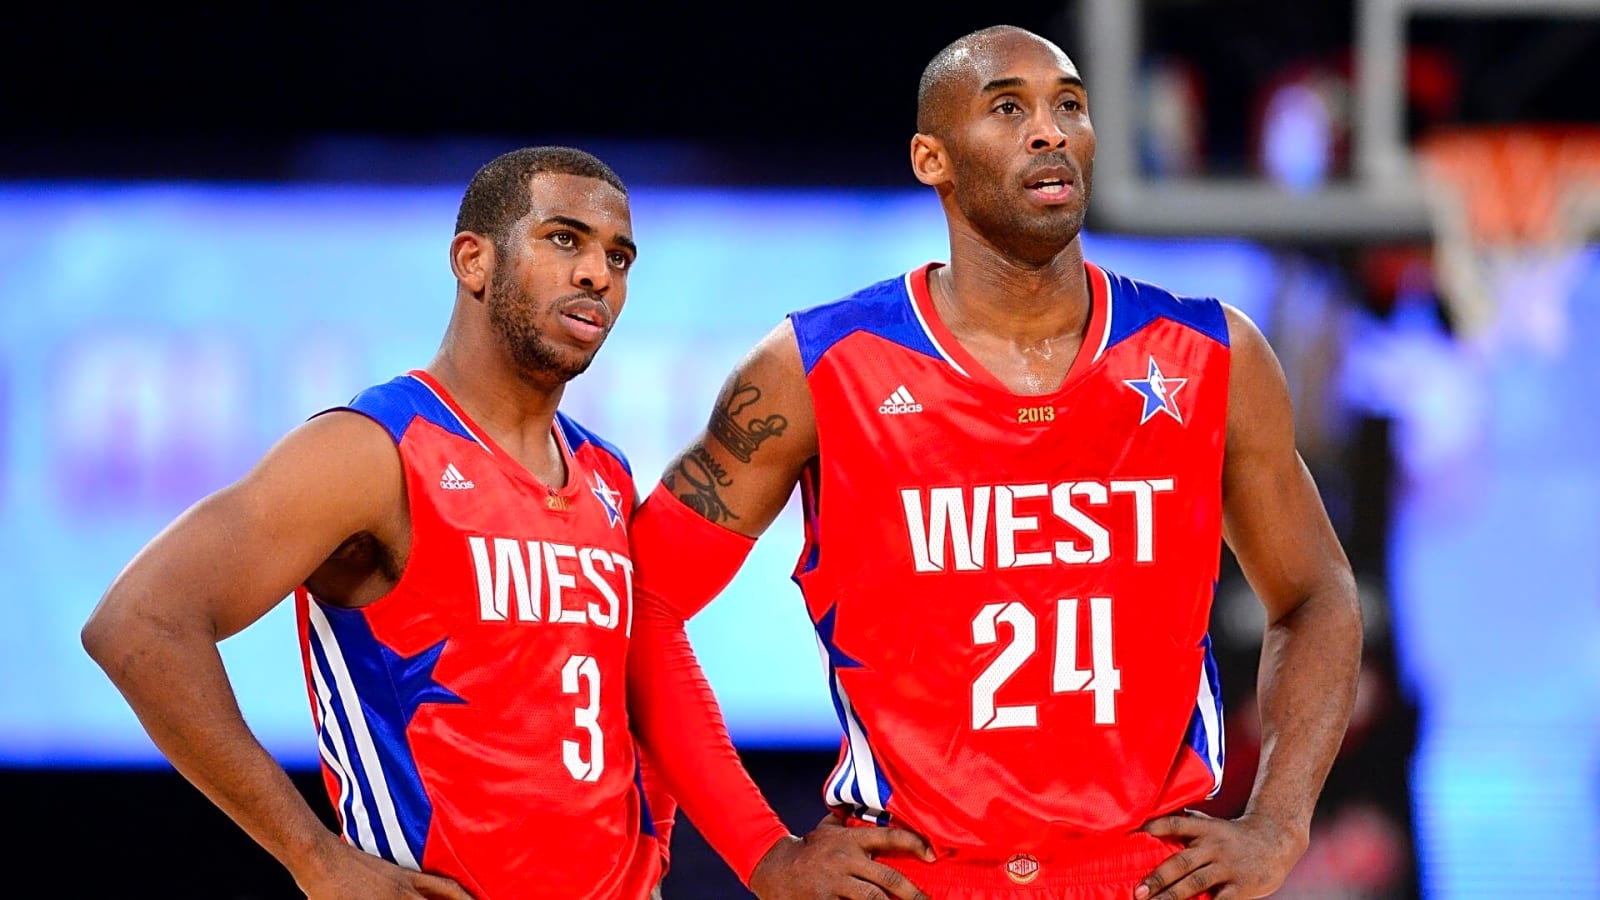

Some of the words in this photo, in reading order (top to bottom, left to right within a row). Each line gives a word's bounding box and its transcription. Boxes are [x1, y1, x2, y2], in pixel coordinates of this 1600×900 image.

[878, 402, 923, 415] adidas
[1018, 406, 1055, 424] 2013
[440, 479, 475, 490] adidas
[900, 478, 1175, 572] WEST
[468, 536, 634, 639] WEST
[971, 597, 1121, 731] 24
[561, 654, 605, 783] 3
